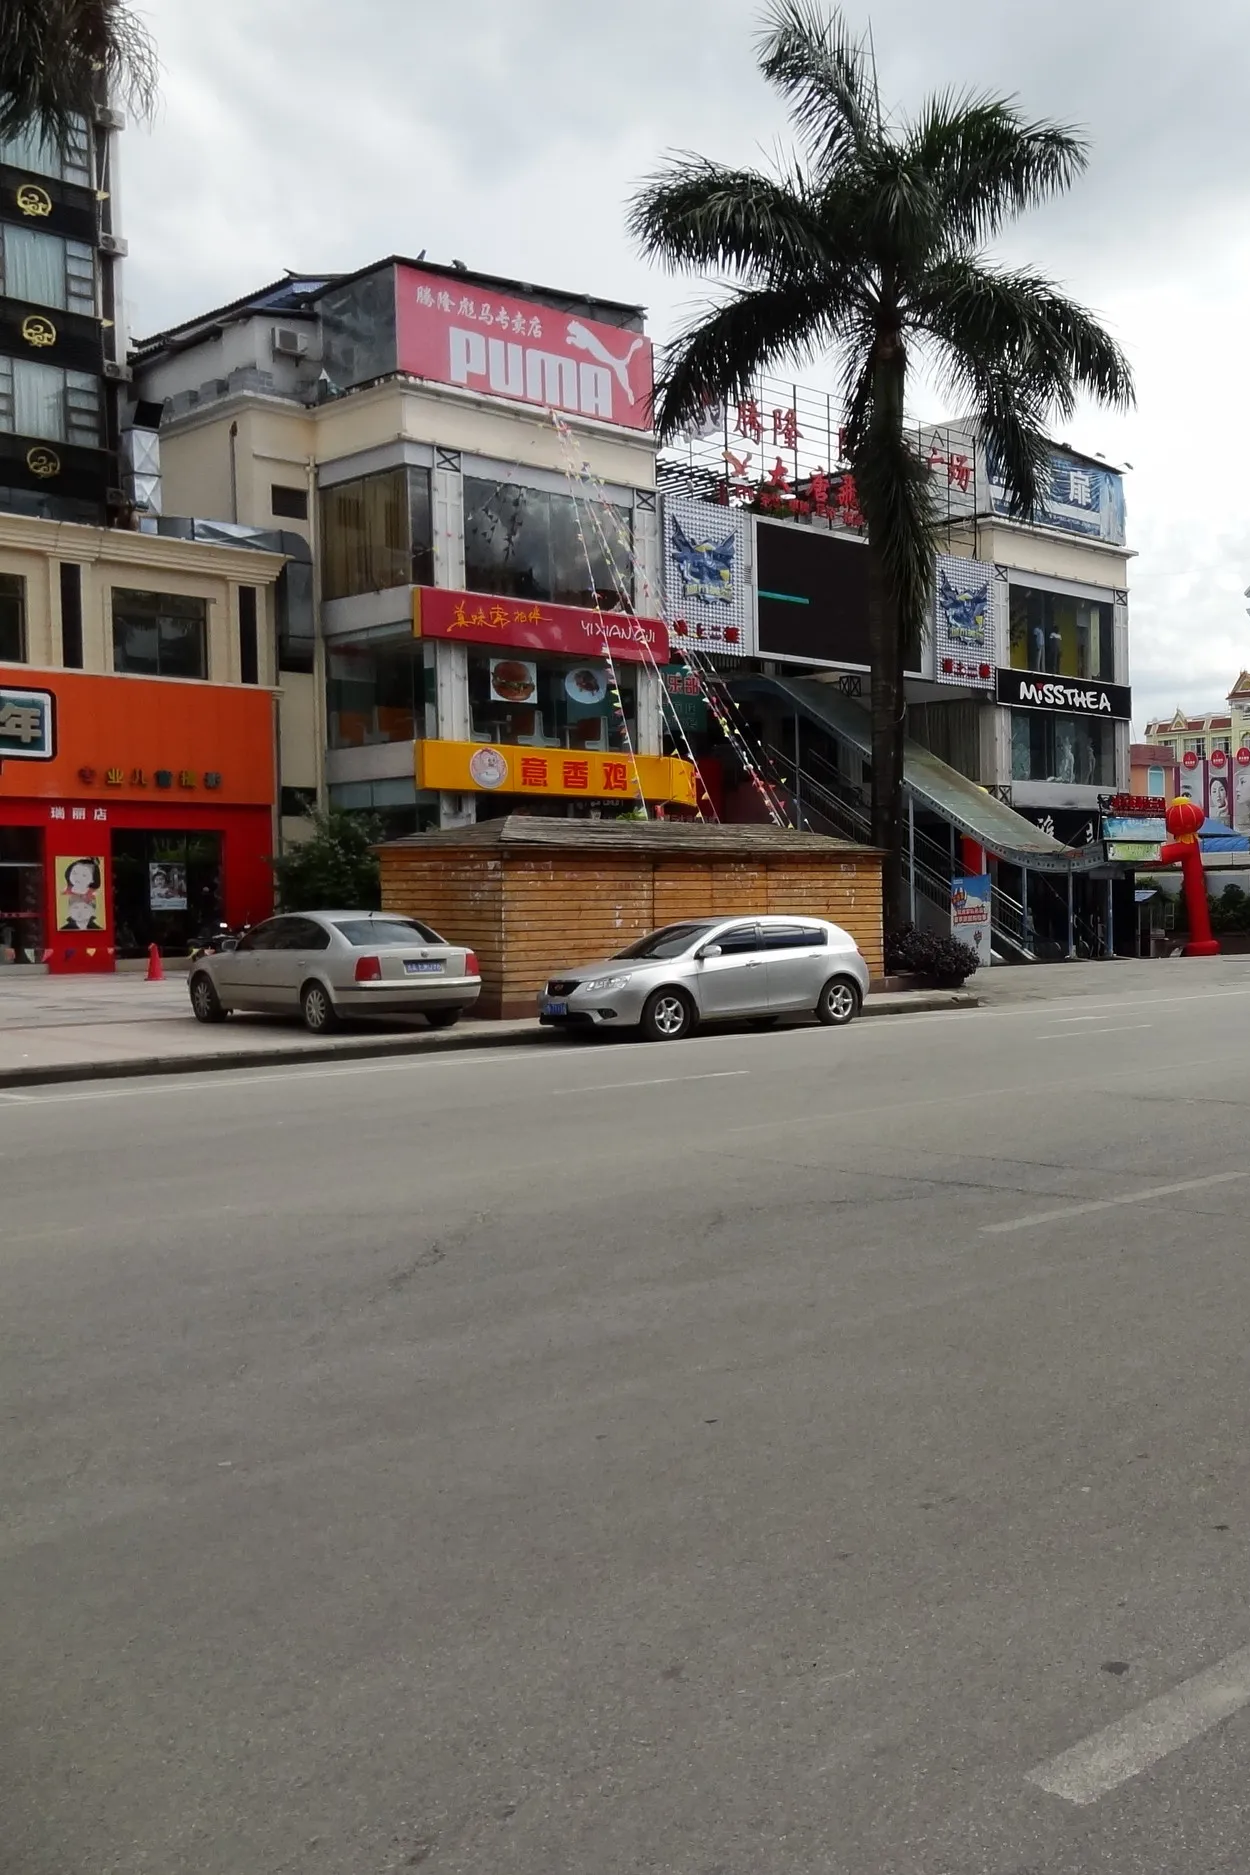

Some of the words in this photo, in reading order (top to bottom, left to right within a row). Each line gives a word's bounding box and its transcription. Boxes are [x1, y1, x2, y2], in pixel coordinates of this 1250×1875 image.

[449, 326, 613, 419] PUMA
[520, 757, 628, 791] 意香鸡
[50, 806, 108, 821] 瑞丽店
